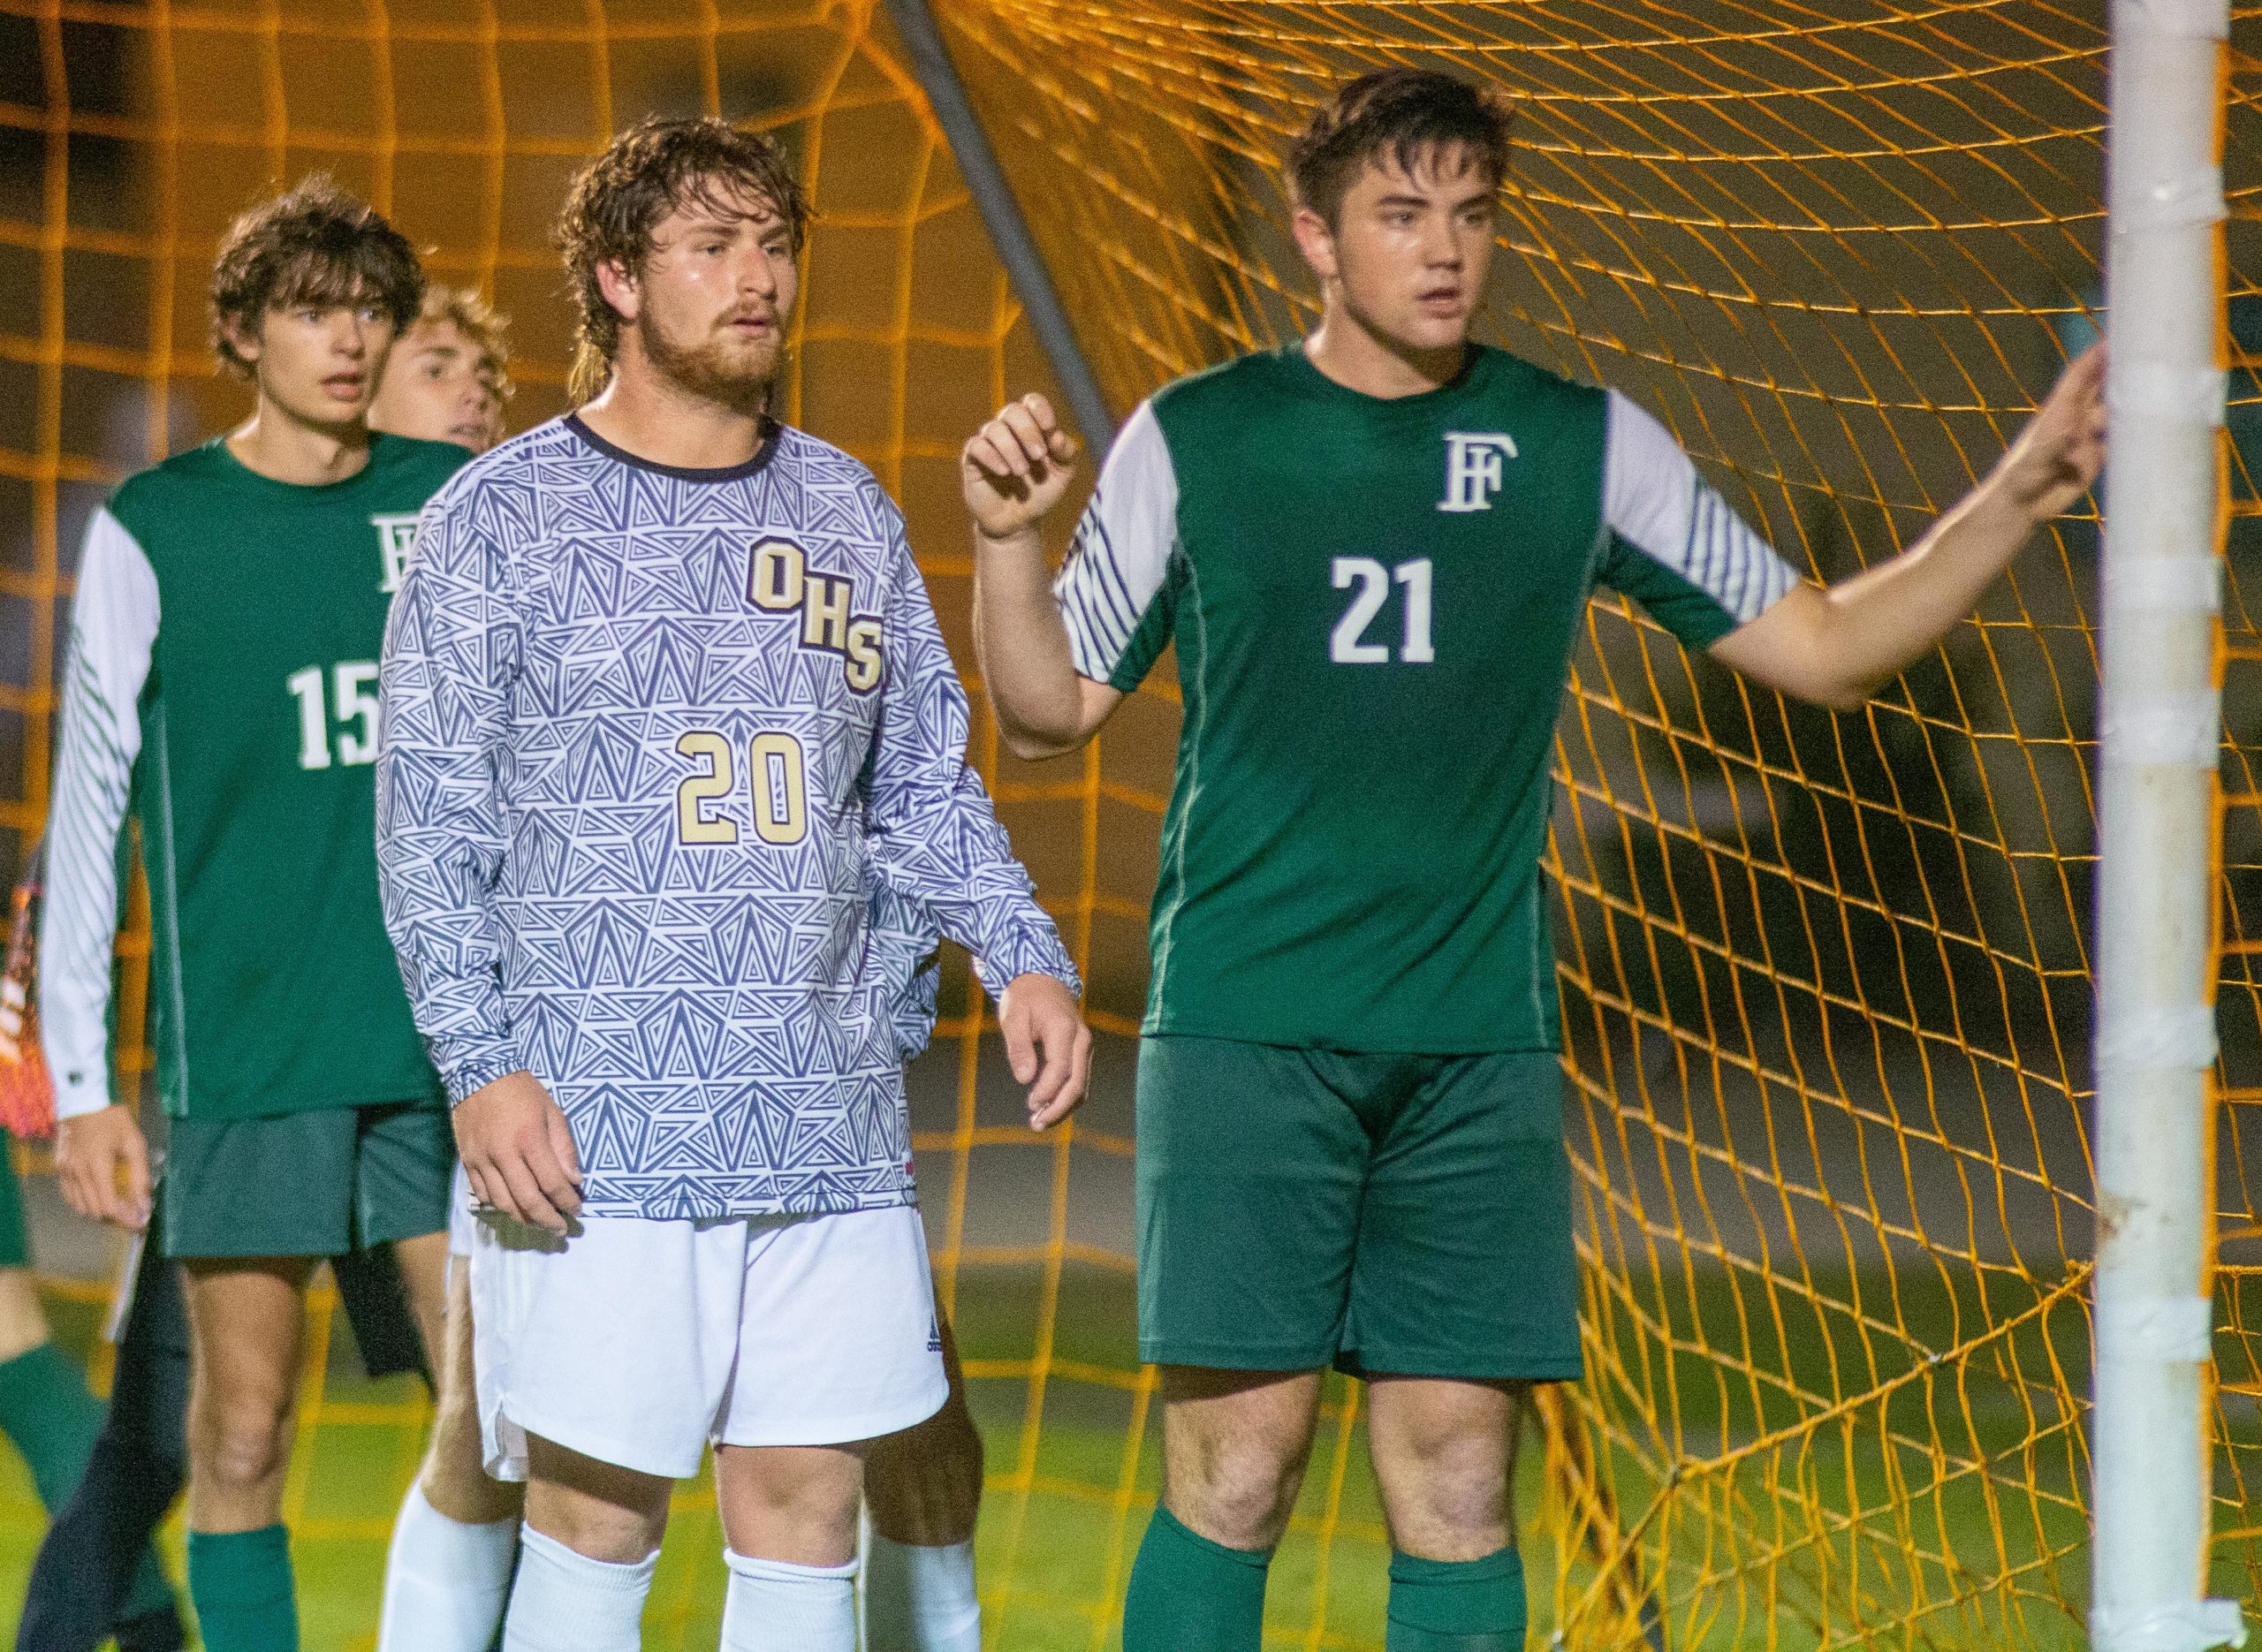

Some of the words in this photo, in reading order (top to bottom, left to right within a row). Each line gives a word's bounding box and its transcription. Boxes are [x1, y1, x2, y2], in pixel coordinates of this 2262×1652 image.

[747, 534, 888, 694] OHS
[1331, 557, 1435, 663] 21
[289, 664, 378, 769] 15
[676, 731, 808, 845] 20
